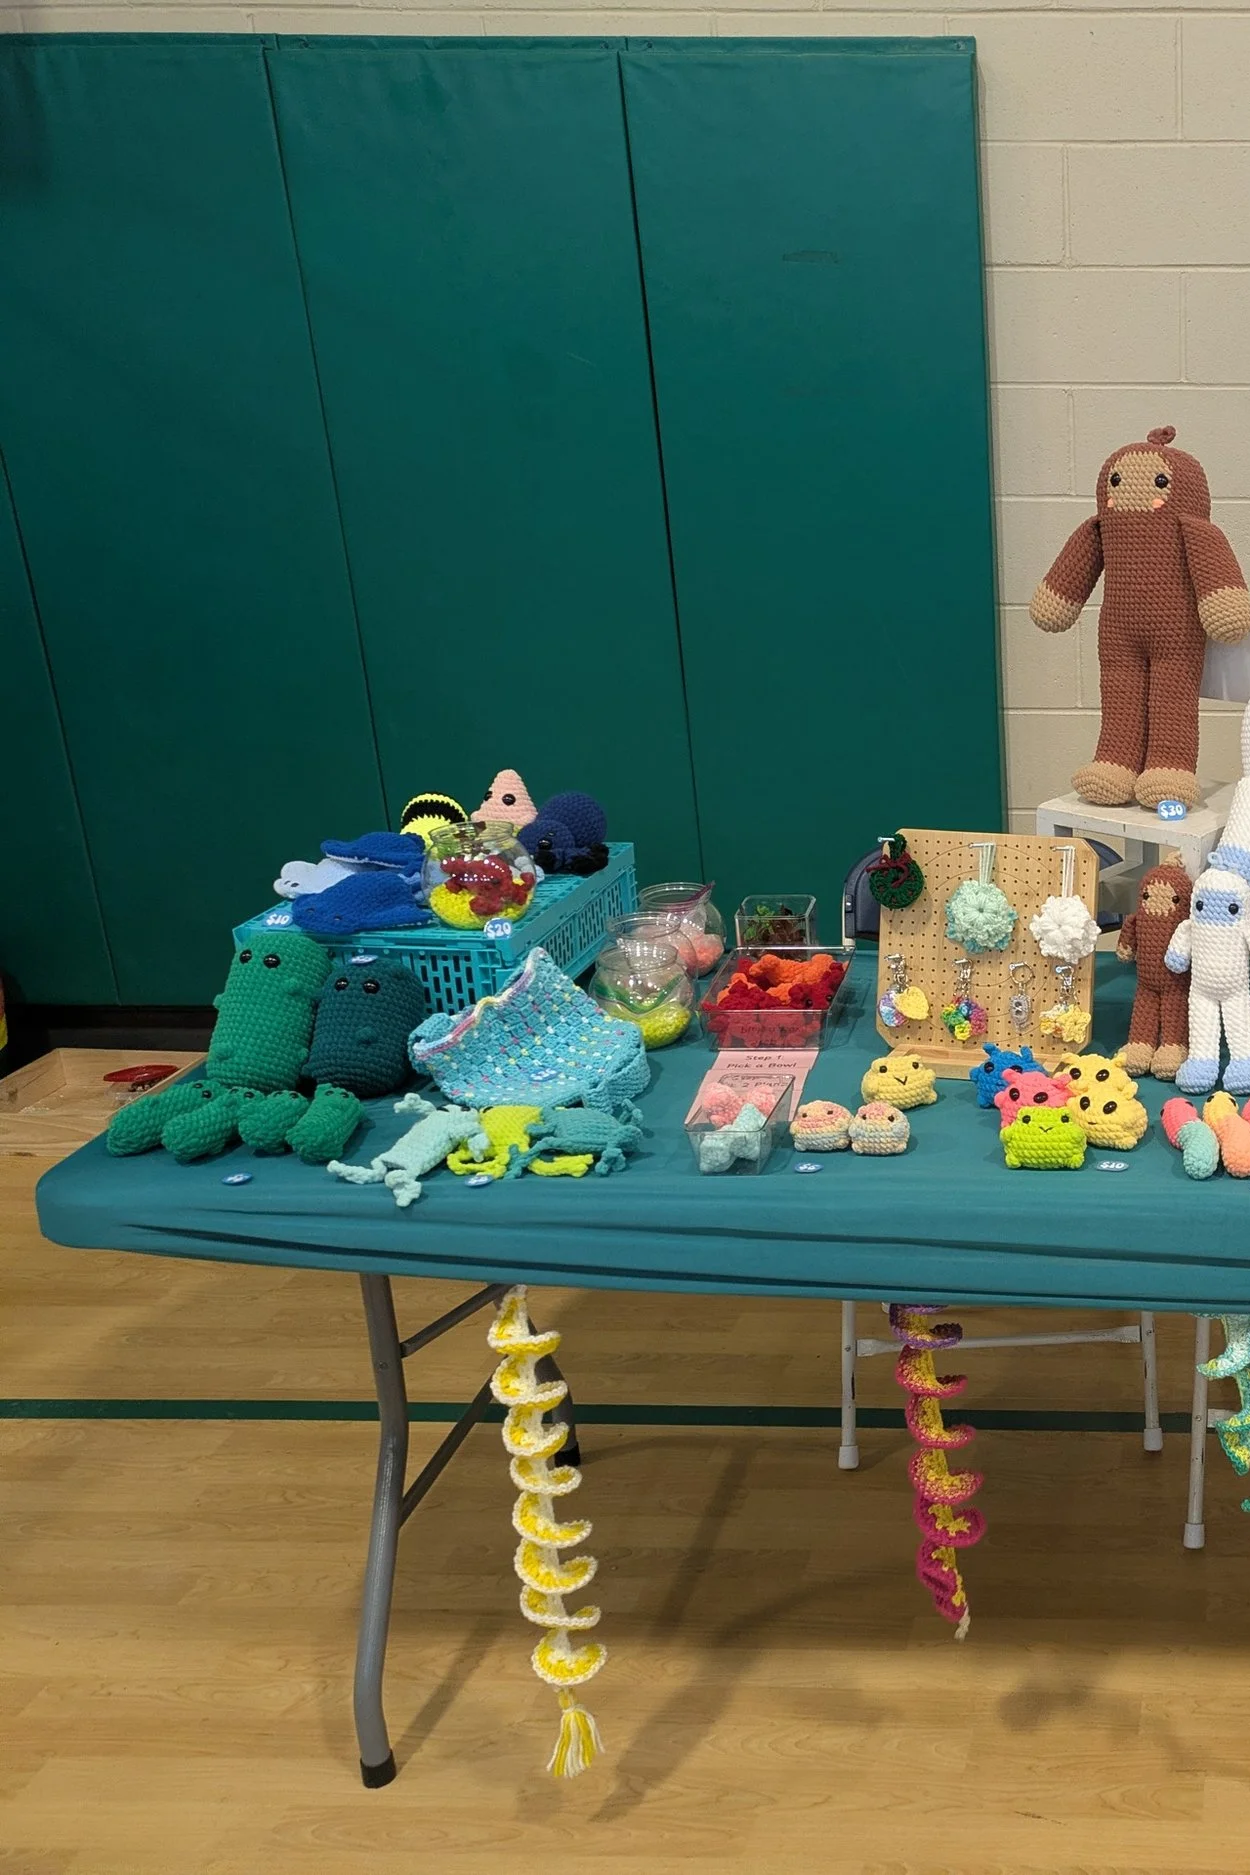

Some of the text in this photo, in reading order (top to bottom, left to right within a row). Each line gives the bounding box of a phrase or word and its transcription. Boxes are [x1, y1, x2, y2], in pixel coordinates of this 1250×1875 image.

[1160, 804, 1184, 819] $30
[266, 913, 290, 926] $10
[486, 921, 512, 939] $20
